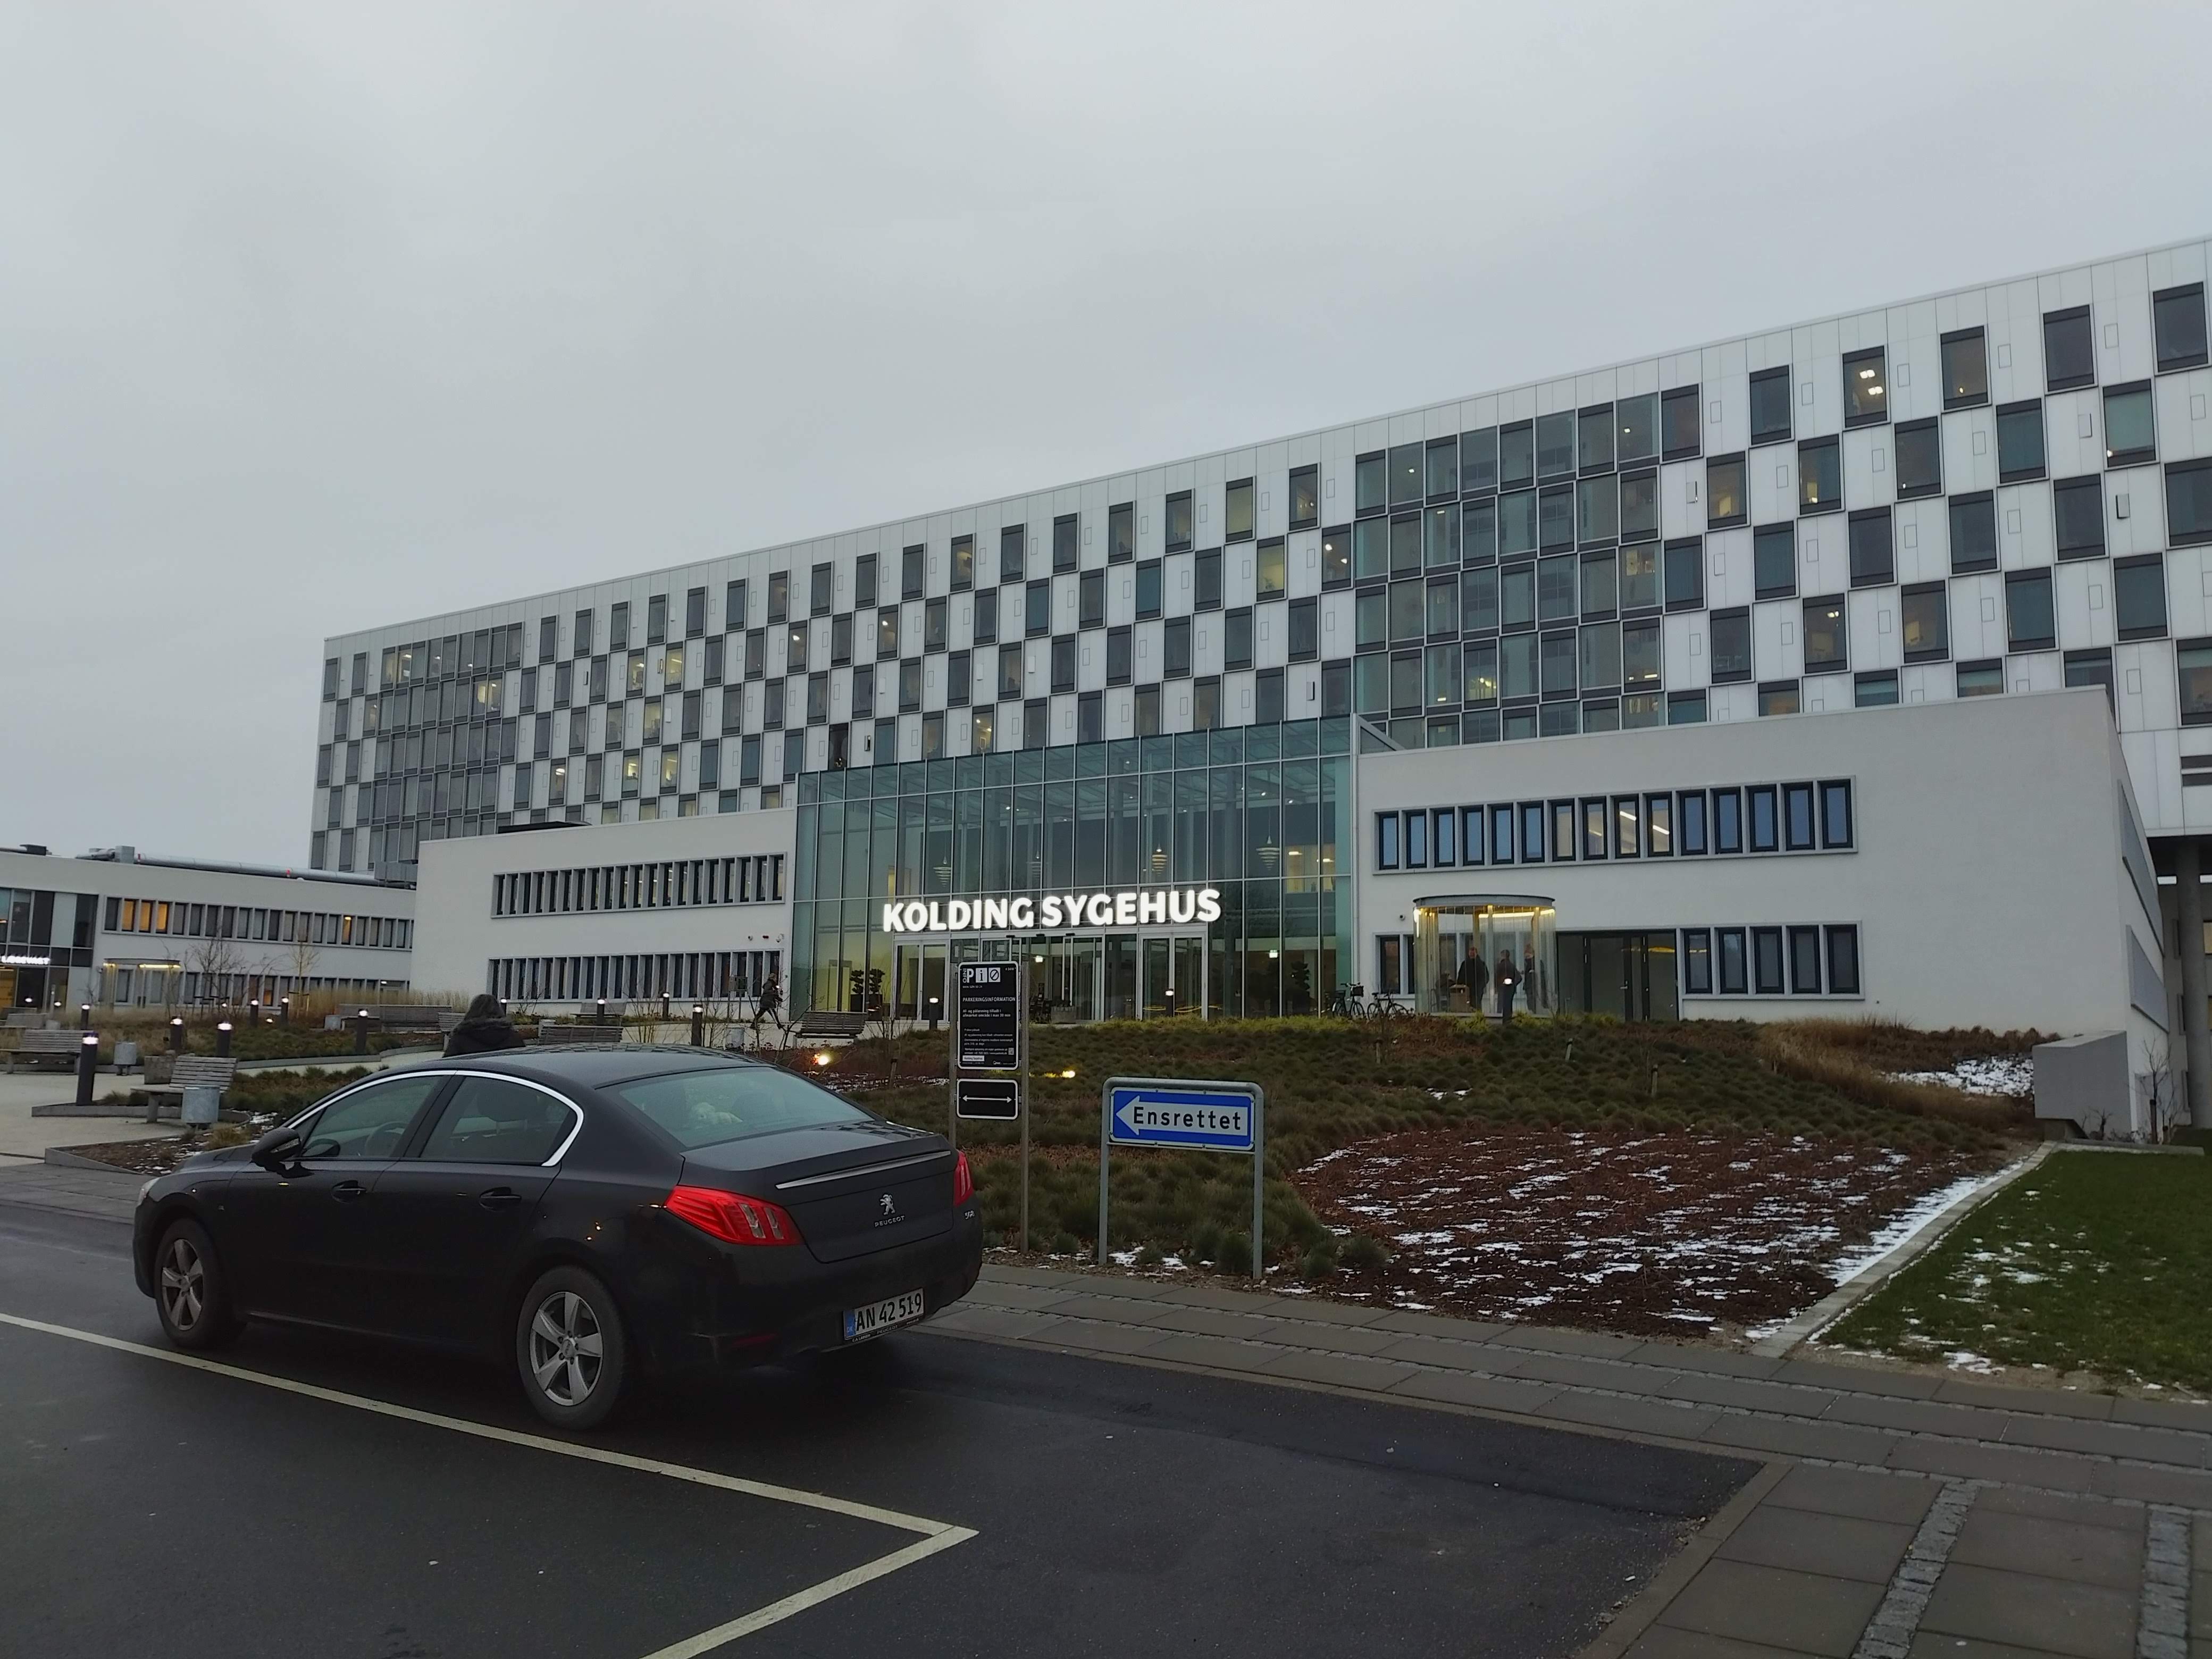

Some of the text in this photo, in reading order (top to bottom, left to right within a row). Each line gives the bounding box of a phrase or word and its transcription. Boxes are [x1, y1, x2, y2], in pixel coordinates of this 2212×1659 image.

[883, 888, 1221, 932] KOLDING SYGEHUS
[967, 968, 974, 983] P
[1134, 1106, 1241, 1130] Ensrettet
[874, 1216, 905, 1227] PEUGEOT
[856, 1293, 922, 1331] AN 42 519
